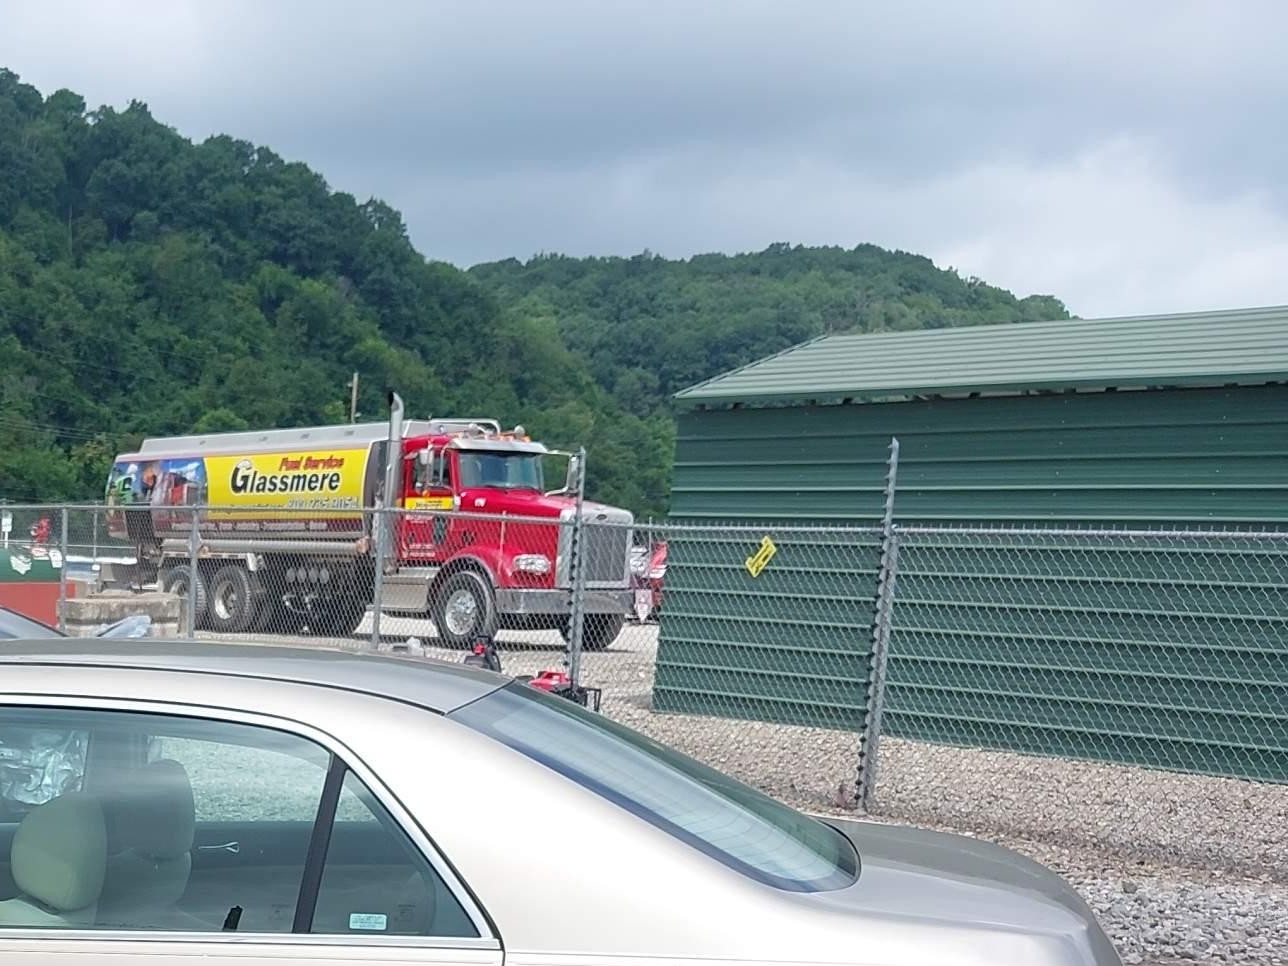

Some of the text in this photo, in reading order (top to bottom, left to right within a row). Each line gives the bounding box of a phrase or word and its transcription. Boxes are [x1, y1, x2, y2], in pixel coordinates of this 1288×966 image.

[279, 454, 344, 471] Fuel Service
[230, 459, 341, 494] Glassmere
